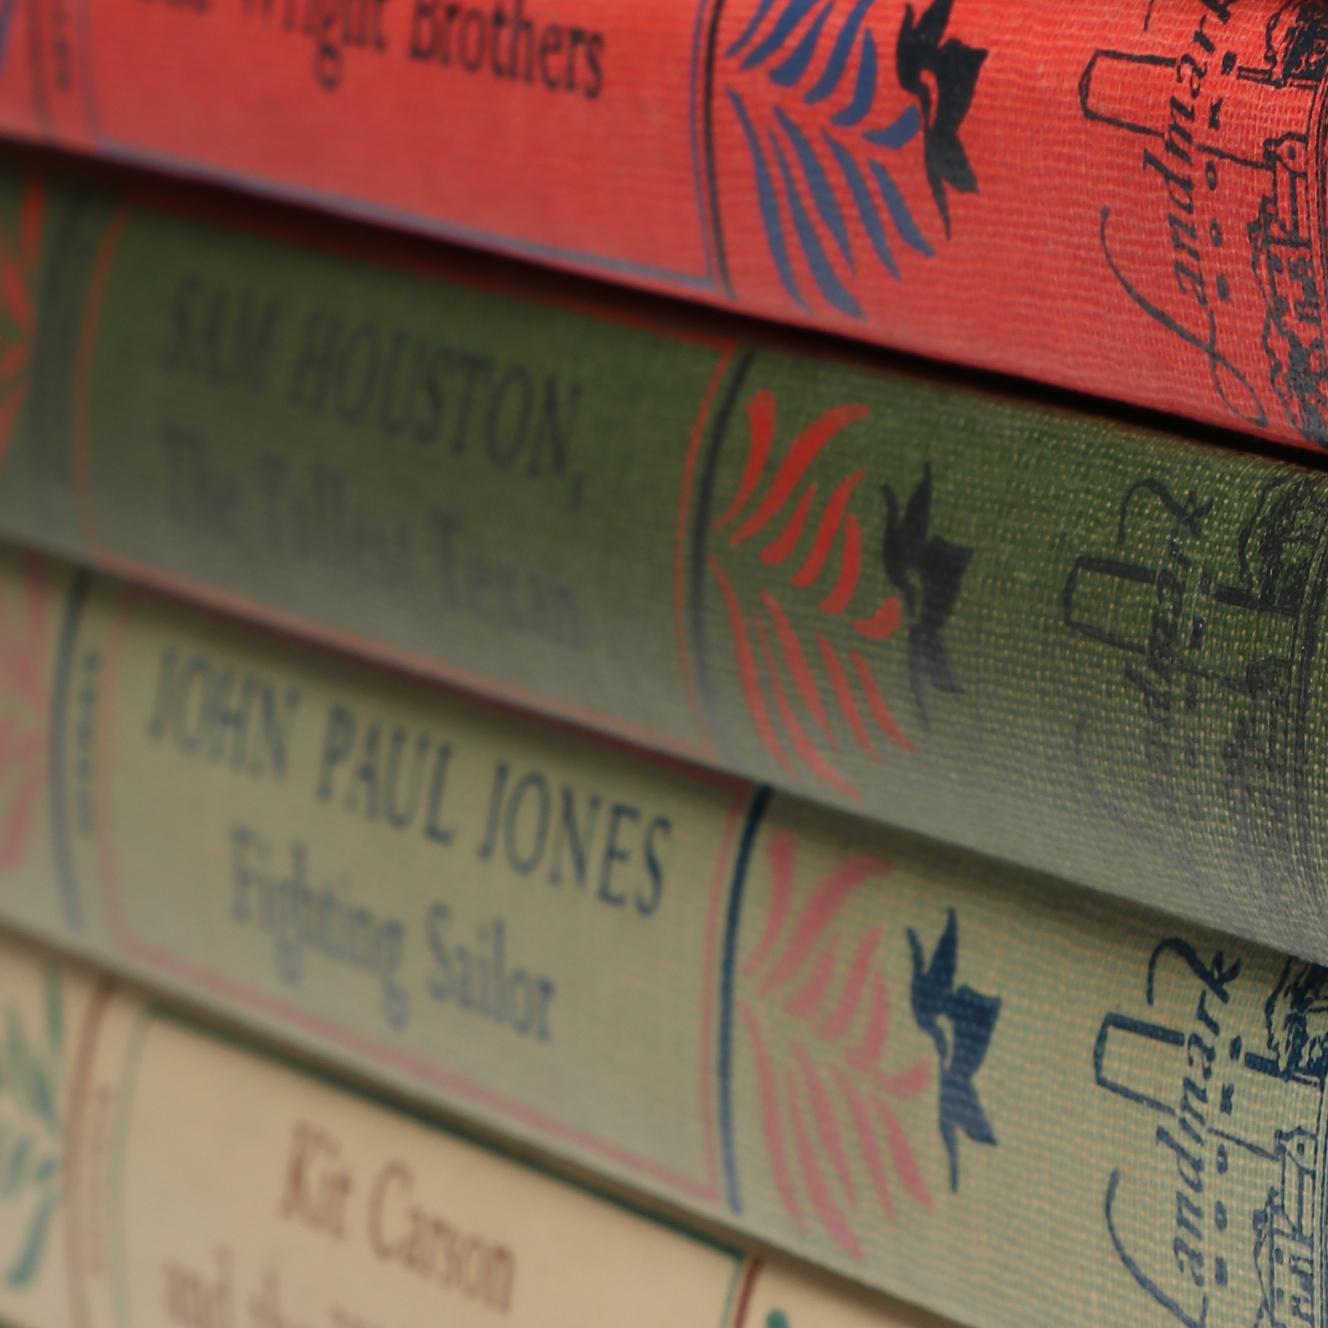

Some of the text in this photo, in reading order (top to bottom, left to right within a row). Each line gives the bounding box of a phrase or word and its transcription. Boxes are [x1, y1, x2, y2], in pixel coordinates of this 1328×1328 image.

[162, 272, 281, 393] SAM
[147, 644, 301, 782] JOHN
[316, 702, 459, 848] PAUL
[478, 758, 675, 918] JONES
[226, 821, 556, 1044] Fighting Sailor
[279, 1119, 353, 1244] Kit
[367, 1159, 518, 1315] Carson
